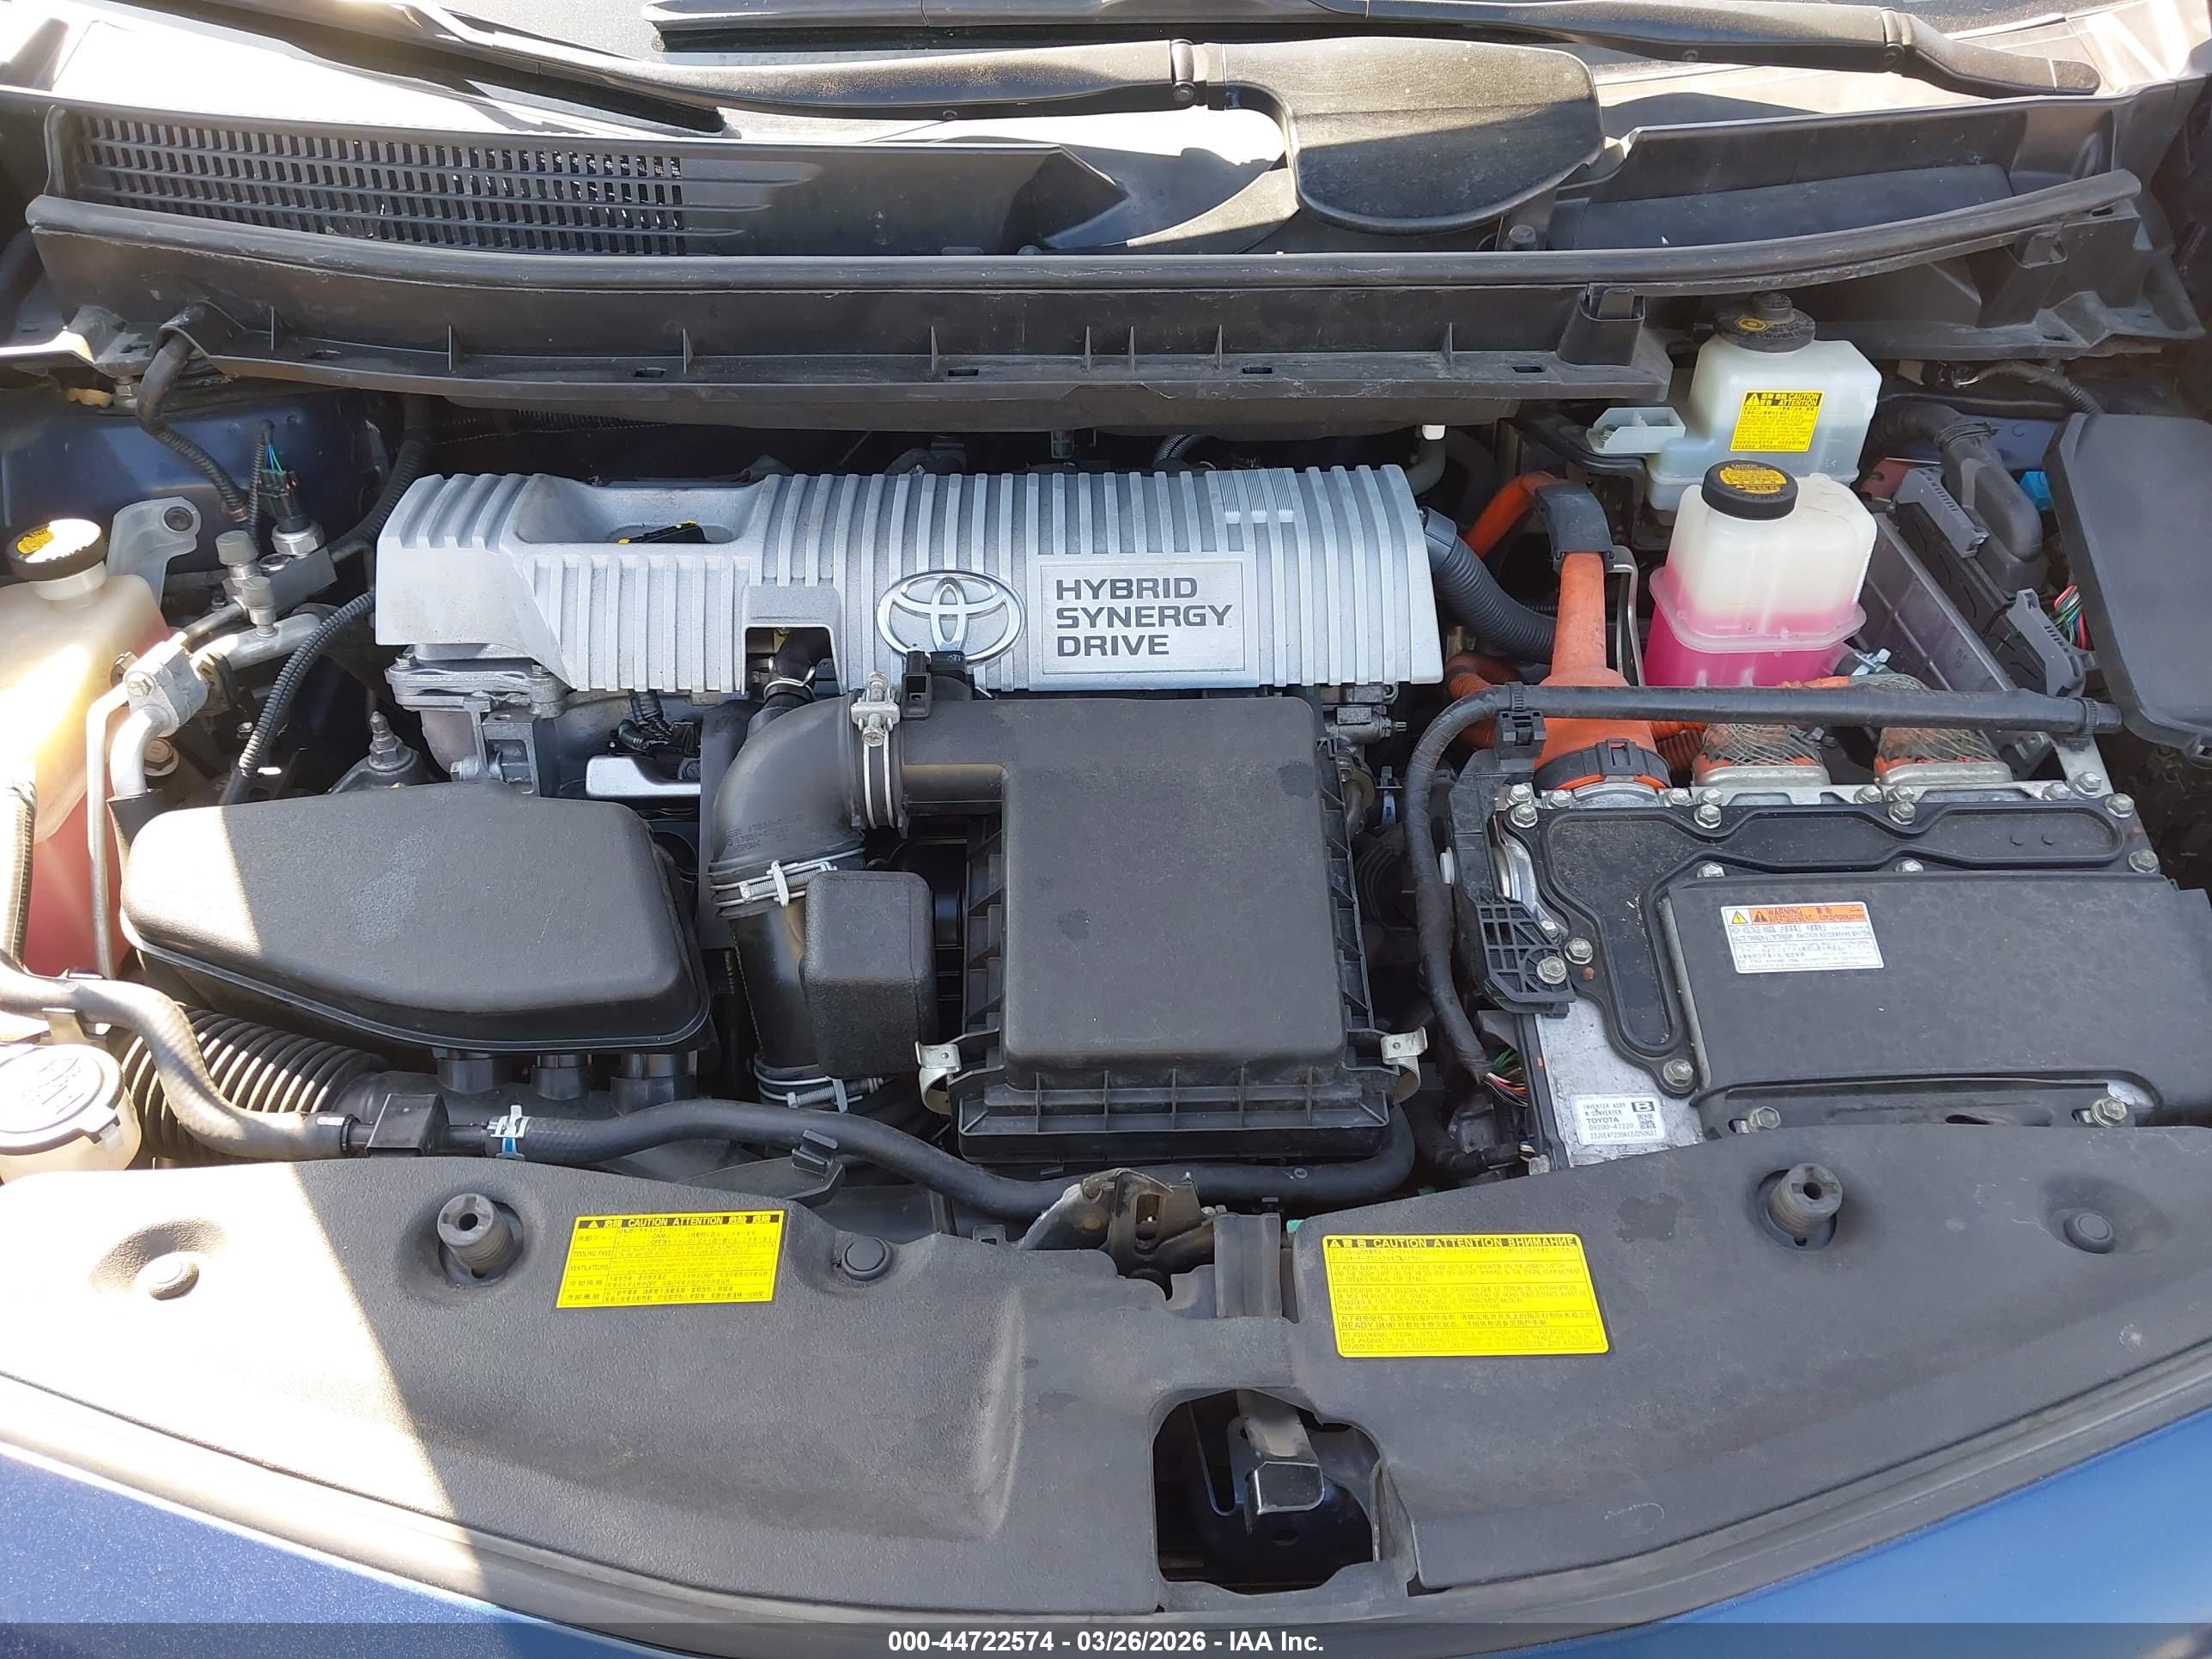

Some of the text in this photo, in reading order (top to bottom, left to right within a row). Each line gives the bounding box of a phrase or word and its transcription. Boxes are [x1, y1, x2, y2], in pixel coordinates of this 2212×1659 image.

[1056, 577, 1198, 600] HYBRID
[1056, 605, 1233, 629] SYNERGY
[1057, 635, 1170, 657] DRIVE
[1767, 907, 1802, 915] WARNING
[1634, 1101, 1652, 1112] B
[628, 1218, 668, 1227] CAUTION
[672, 1216, 723, 1226] ATTENTION
[1374, 1238, 1427, 1248] CAUTION
[1433, 1237, 1503, 1248] ATTENTION
[1508, 1237, 1576, 1247] ВНИМАНИЕ
